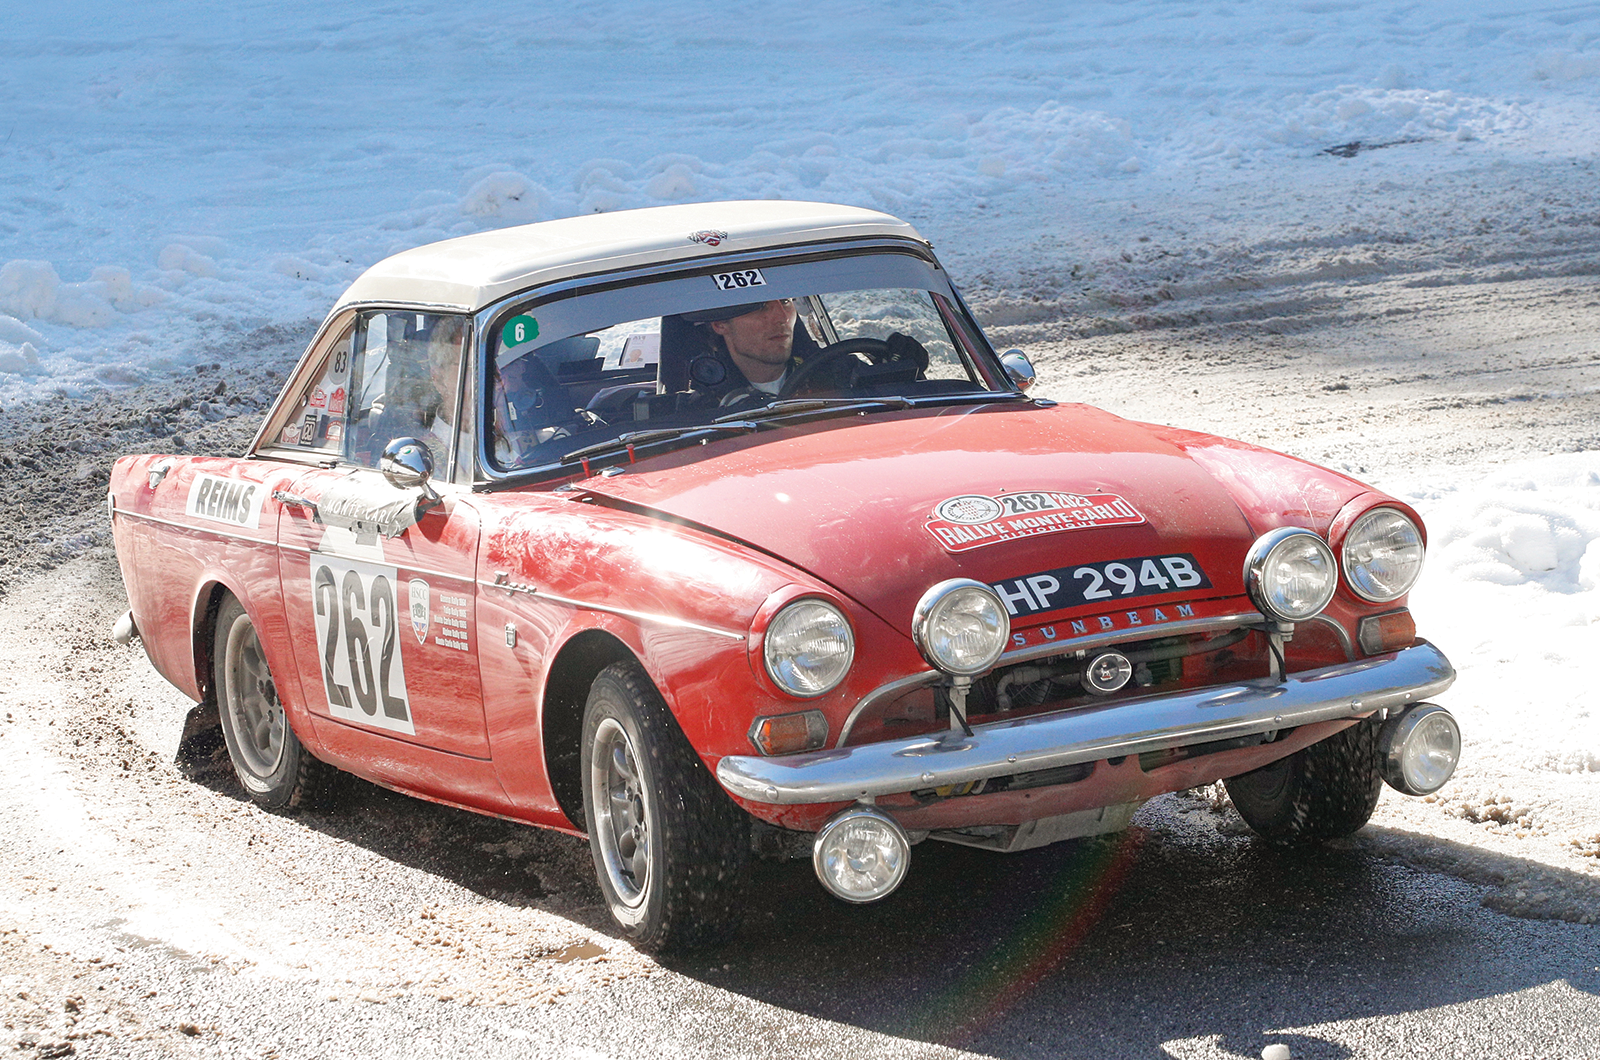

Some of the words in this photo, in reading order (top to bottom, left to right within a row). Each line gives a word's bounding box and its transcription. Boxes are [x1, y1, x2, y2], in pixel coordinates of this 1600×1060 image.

[719, 270, 763, 290] 262
[514, 323, 525, 342] 6
[335, 351, 348, 373] 83
[195, 478, 256, 524] REIMS
[1002, 494, 1054, 513] 262
[1051, 494, 1094, 509] 2023
[936, 520, 1009, 546] RALLYE
[1008, 499, 1136, 531] MONTE-CARLO
[999, 520, 1097, 540] HISTORIQUE
[1074, 557, 1202, 600] 294B
[411, 586, 427, 600] HSCC
[1012, 604, 1195, 646] SUNBEAM
[315, 565, 409, 722] 262
